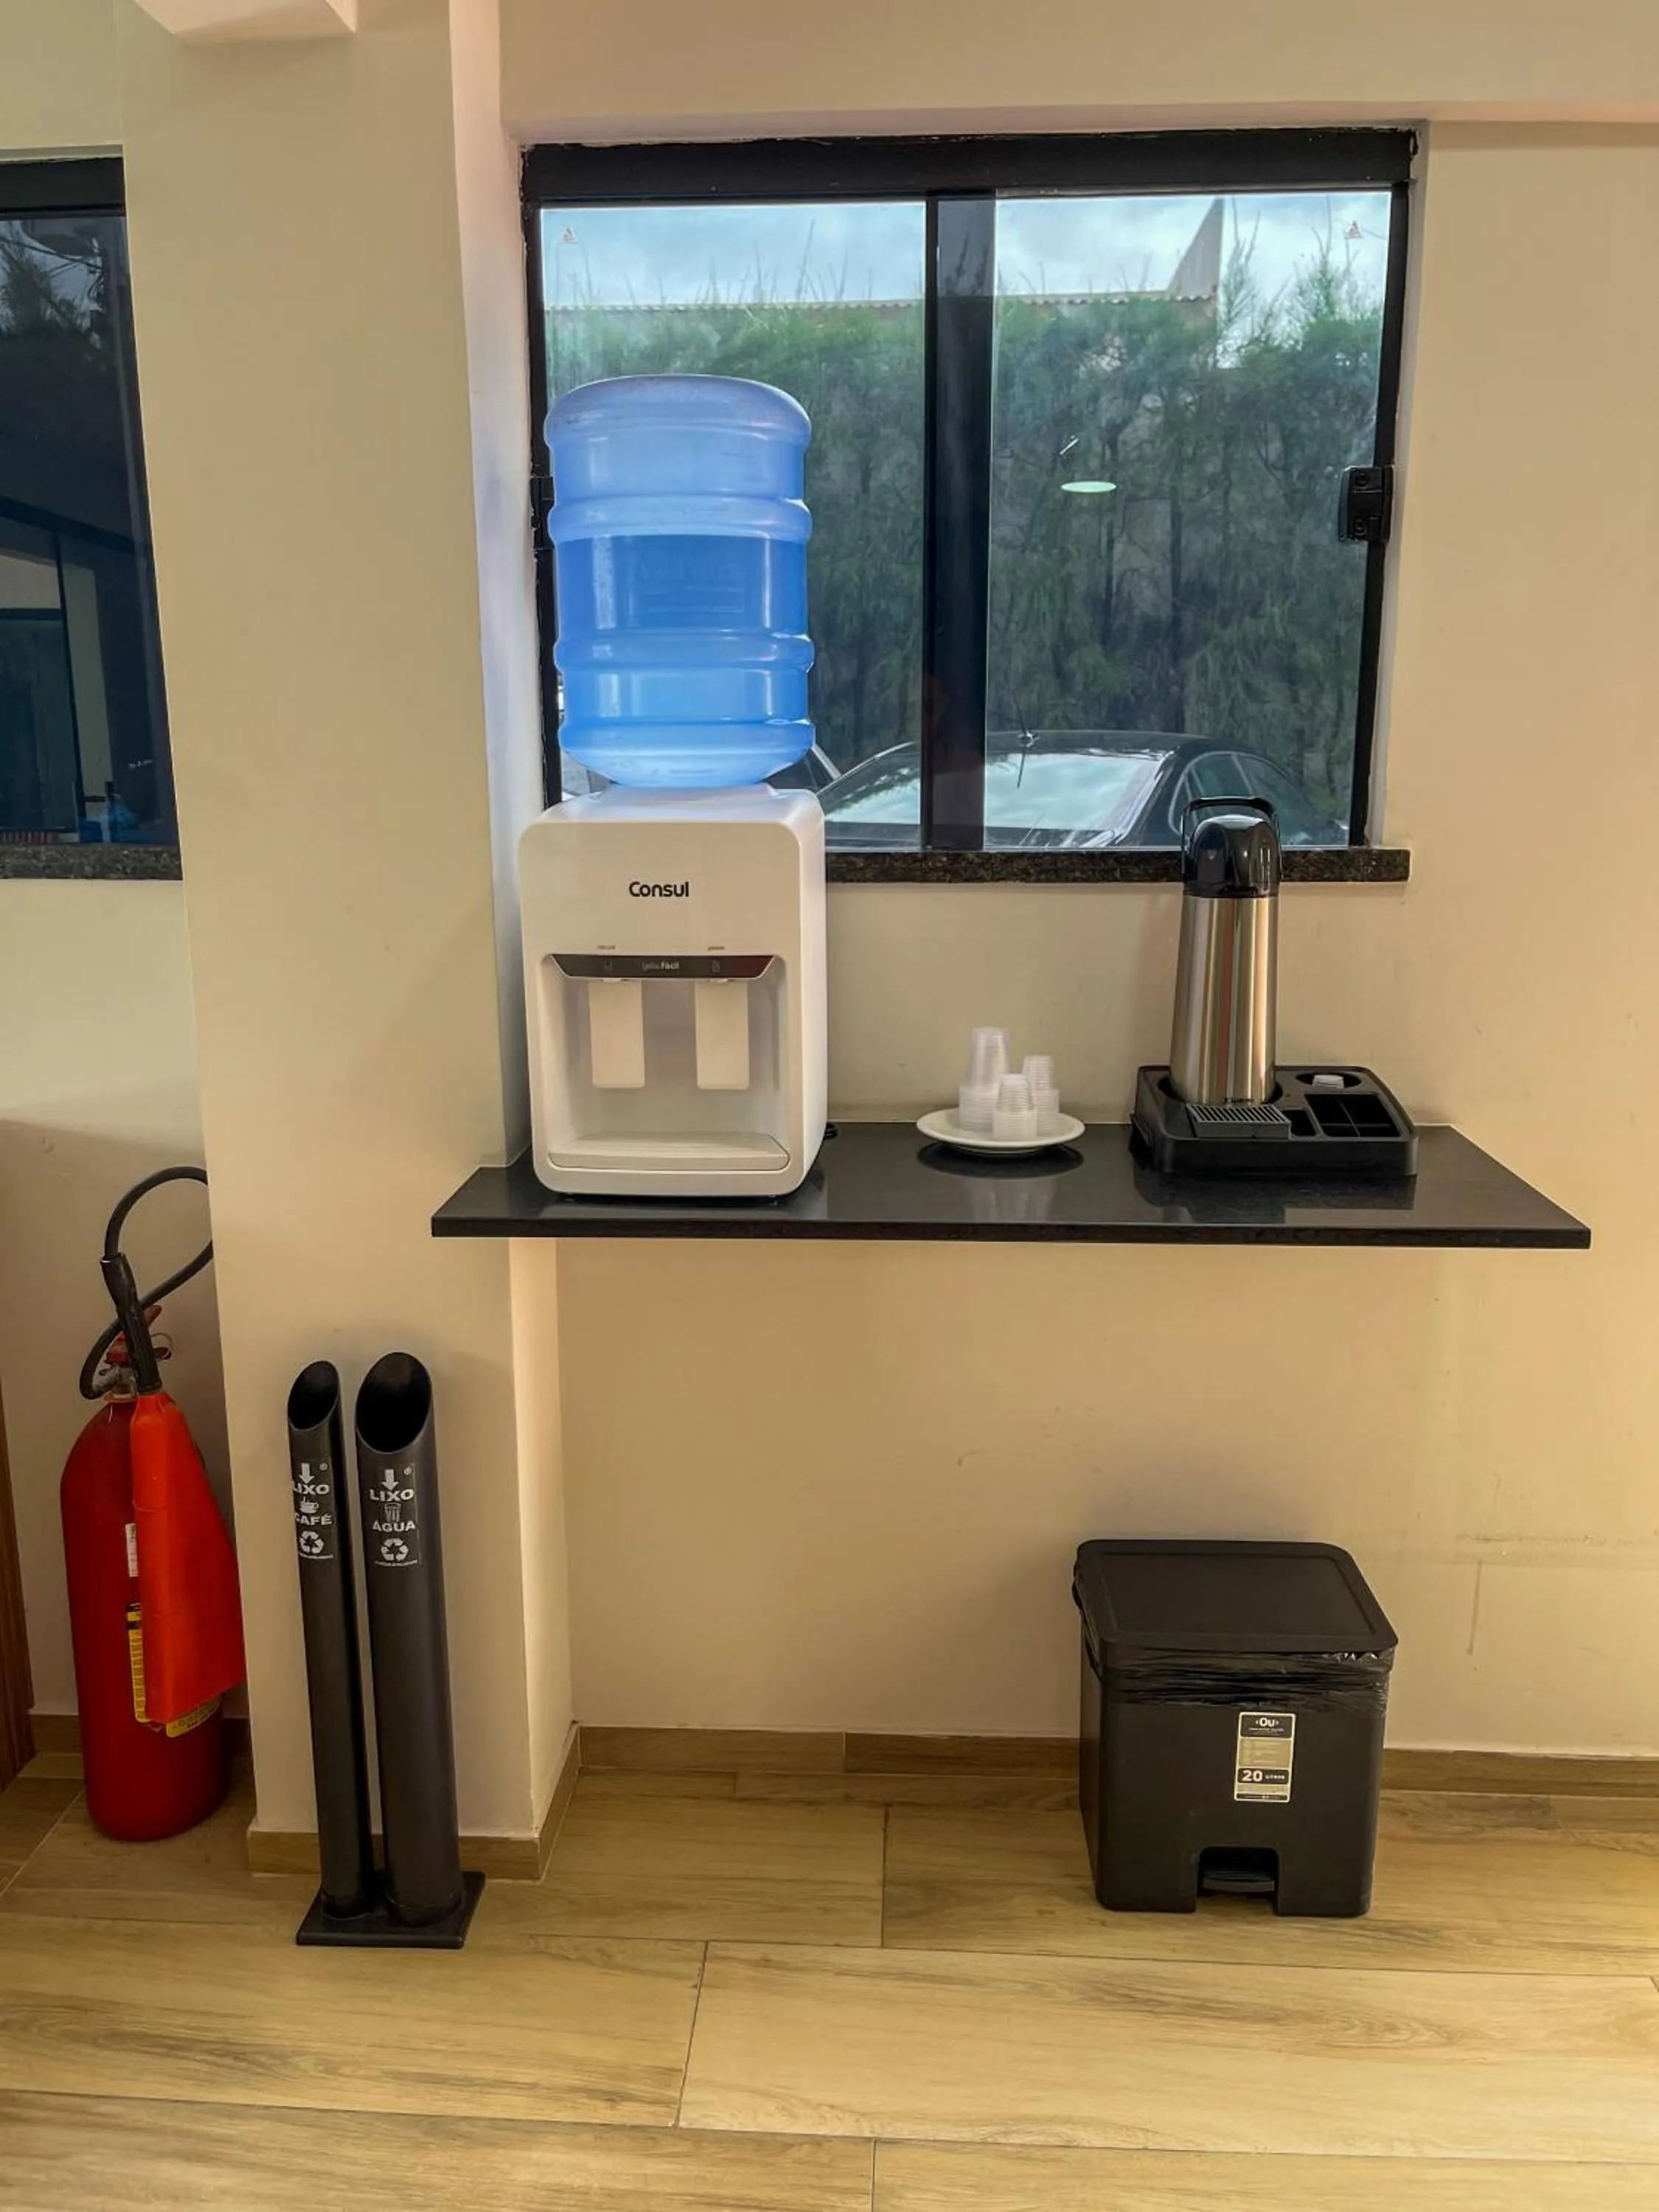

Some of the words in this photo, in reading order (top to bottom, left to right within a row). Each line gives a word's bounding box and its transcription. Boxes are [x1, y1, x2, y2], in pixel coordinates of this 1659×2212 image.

[629, 881, 689, 897] Consul
[369, 1488, 414, 1502] LIXO
[372, 1520, 416, 1532] AGUA
[1242, 1770, 1263, 1782] 20
